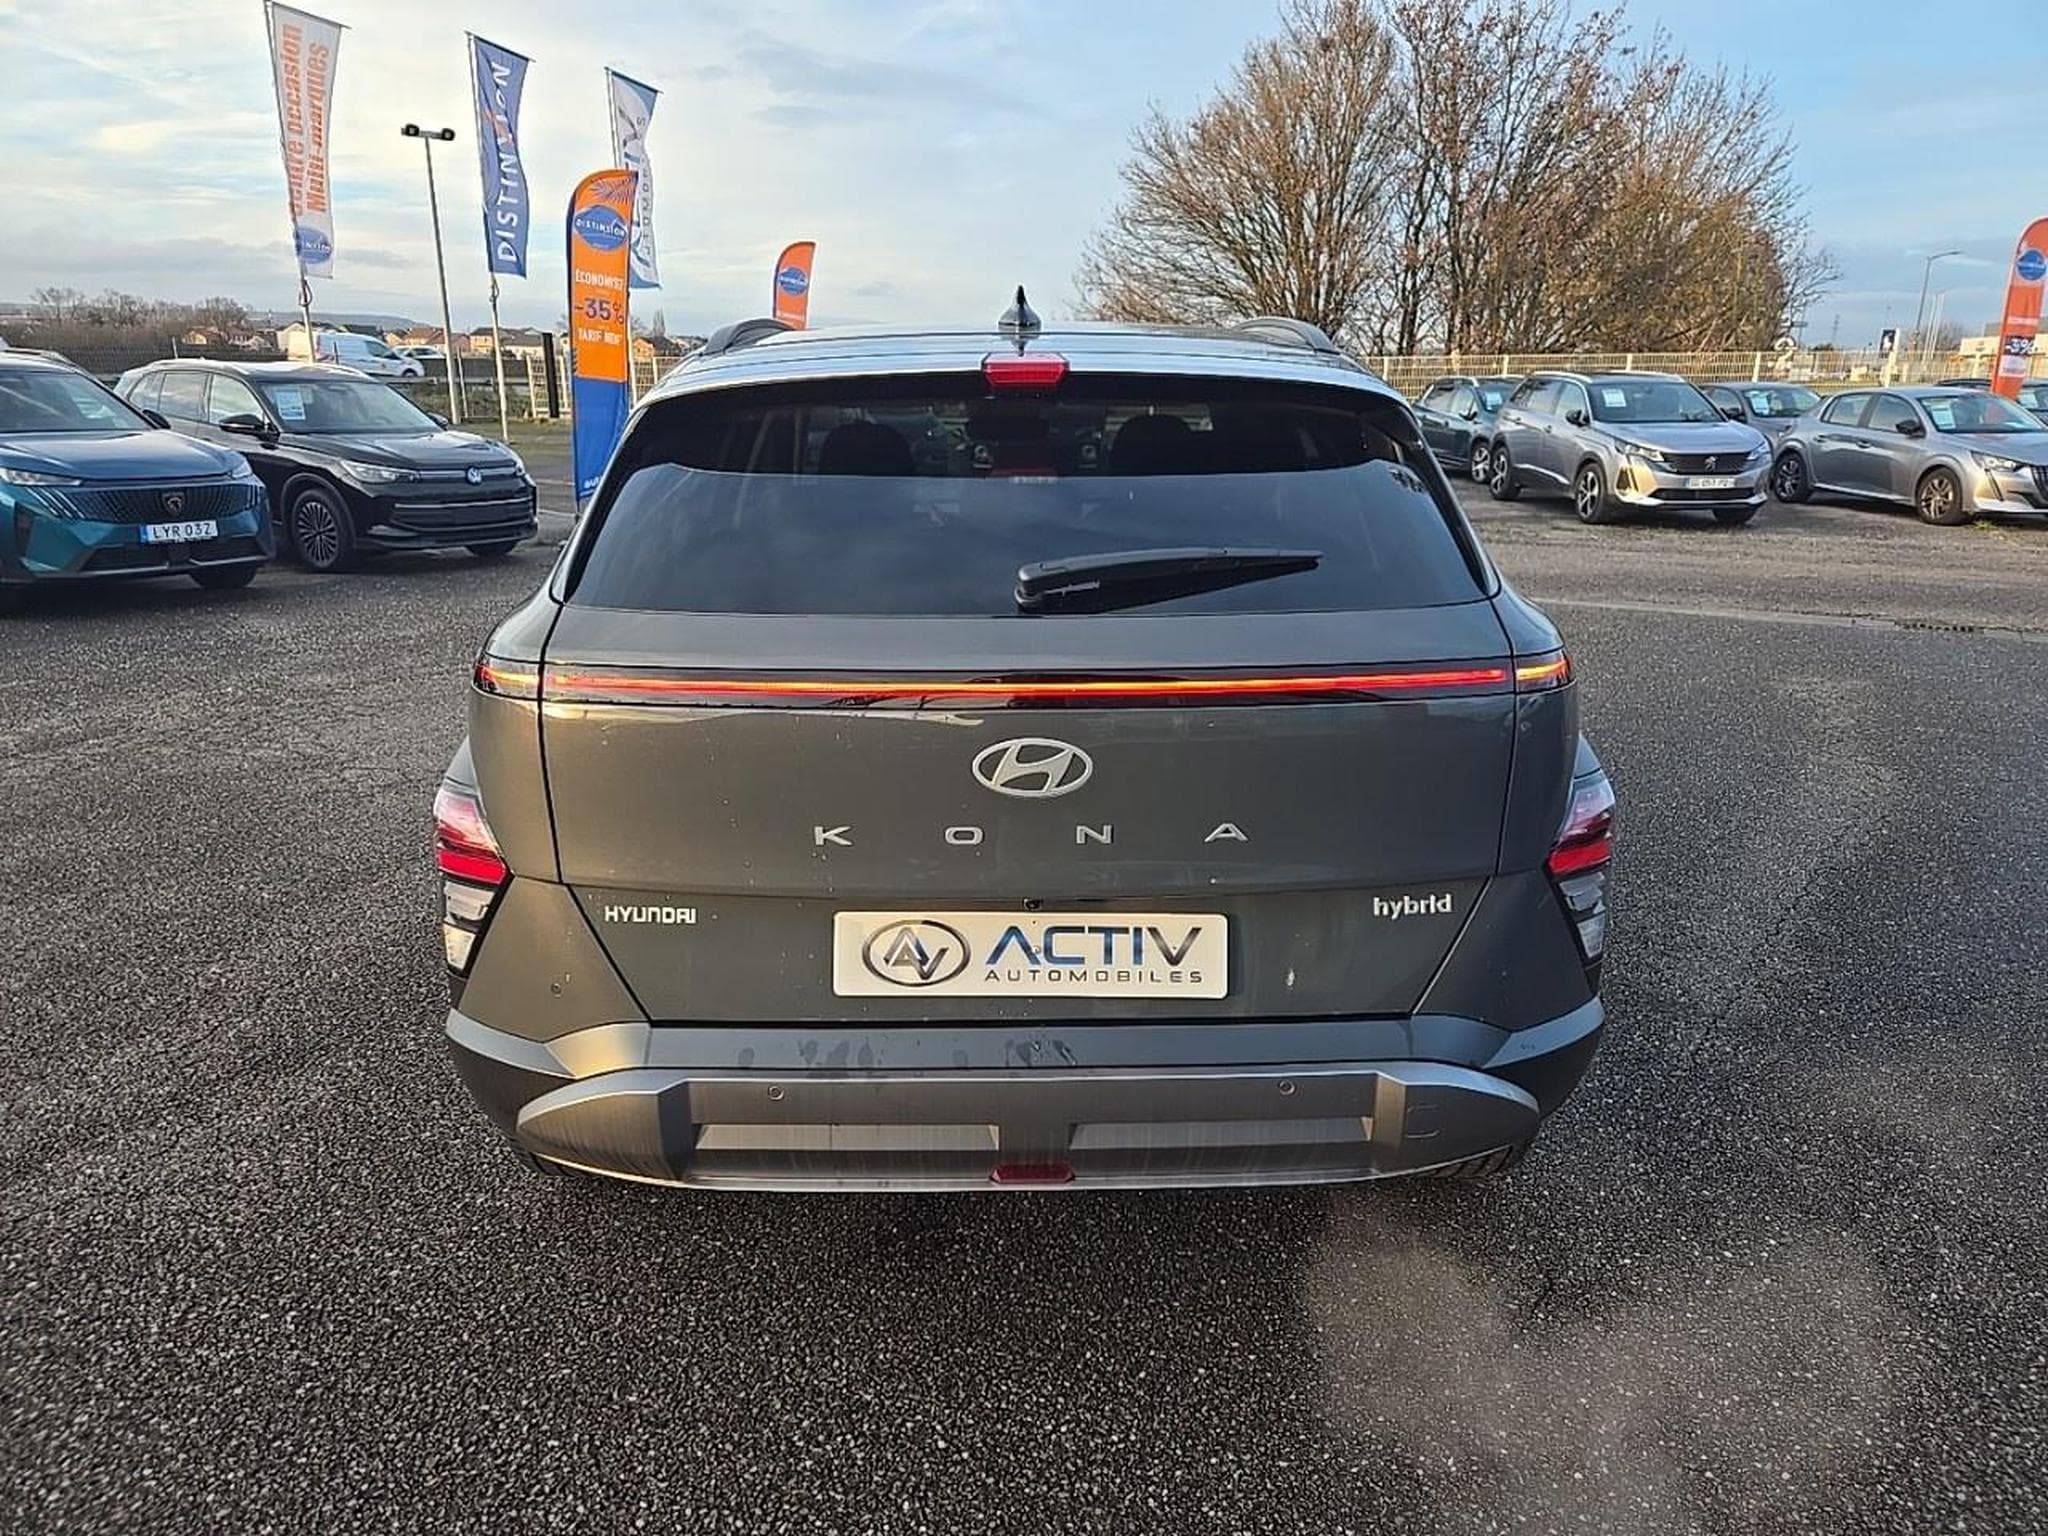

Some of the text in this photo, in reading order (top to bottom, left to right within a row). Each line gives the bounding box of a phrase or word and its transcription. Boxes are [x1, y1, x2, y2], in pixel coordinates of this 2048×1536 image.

[575, 298, 624, 325] -35%
[153, 525, 181, 538] LYR
[814, 823, 1249, 846] KONA
[604, 905, 697, 924] HYUNDAI
[1373, 893, 1452, 920] hybrid
[985, 925, 1203, 966] ACTIV
[984, 968, 1203, 984] AUTOMOBILES
